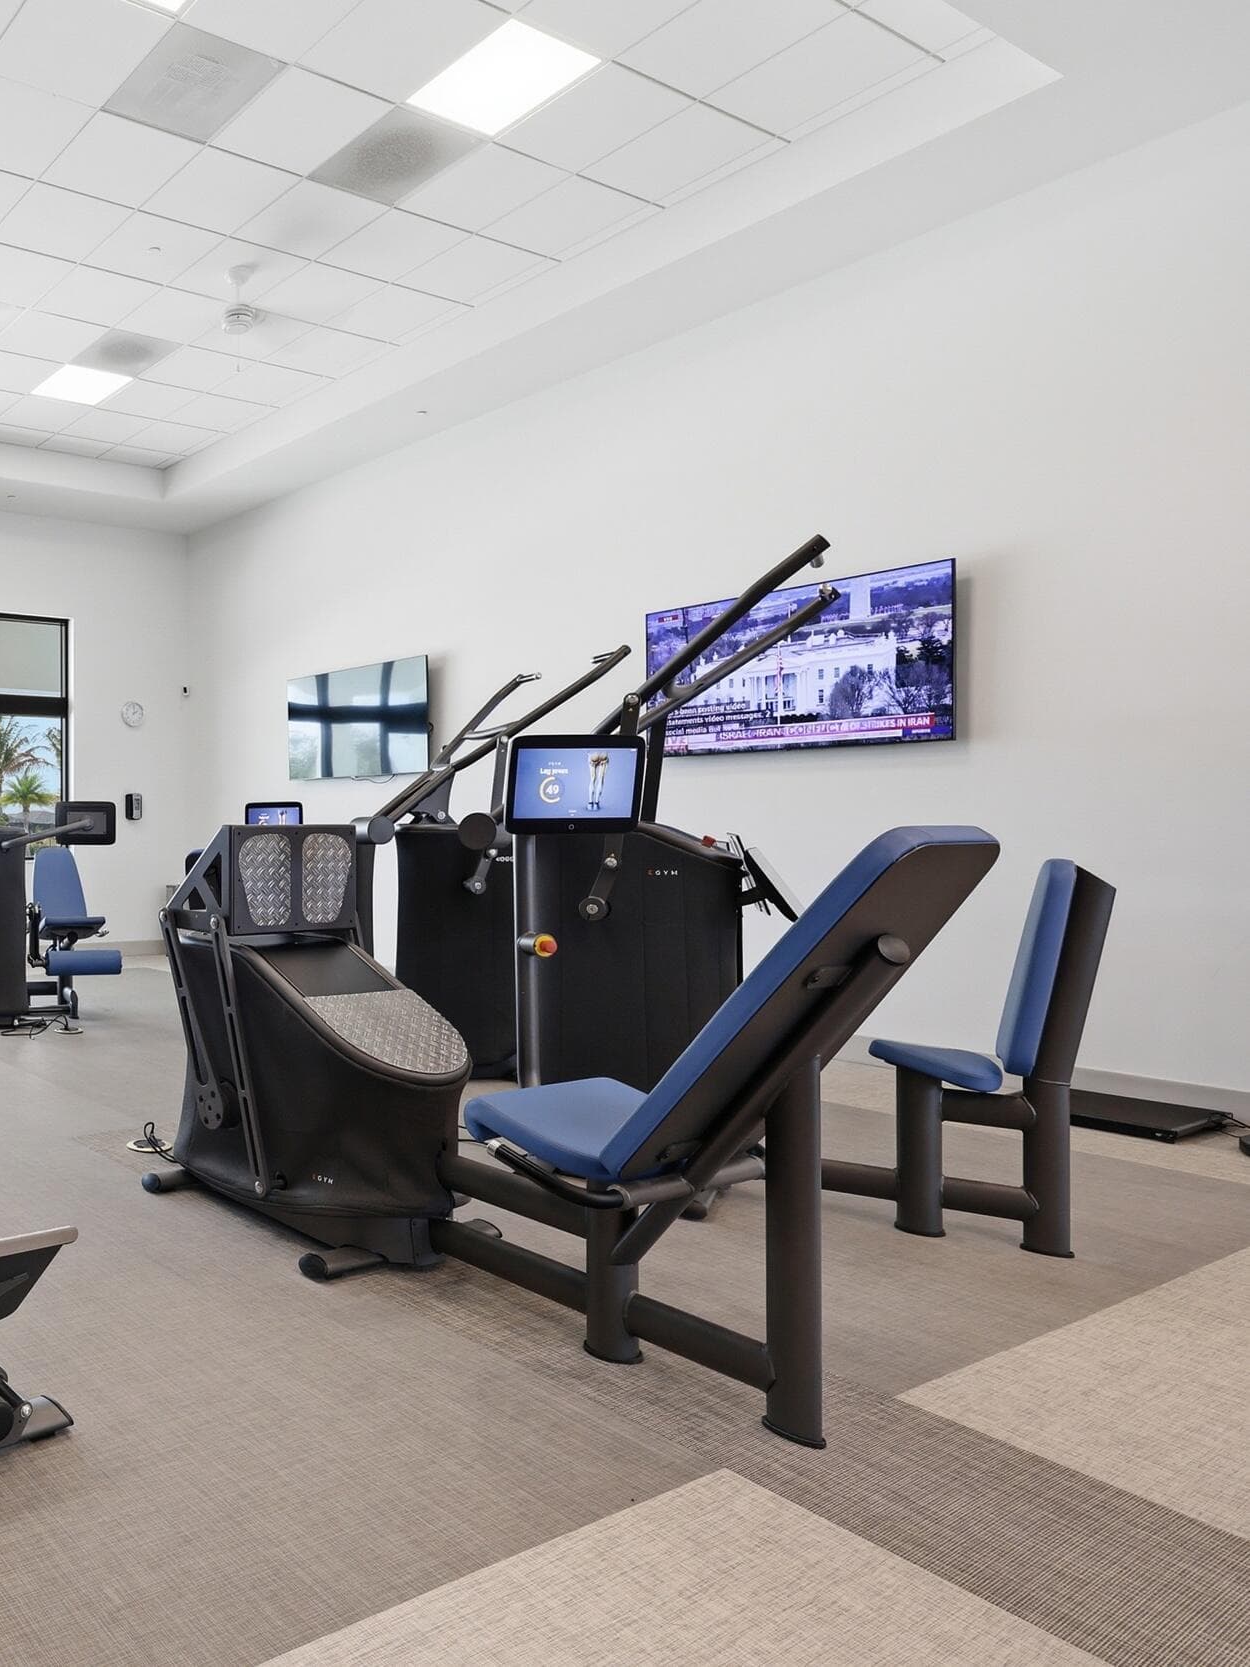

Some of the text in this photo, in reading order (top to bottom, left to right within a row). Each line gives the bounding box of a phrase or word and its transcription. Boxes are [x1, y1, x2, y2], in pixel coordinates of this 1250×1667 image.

[726, 702, 746, 711] video
[704, 714, 724, 722] video
[897, 717, 906, 727] IN
[907, 716, 930, 727] IRAN
[545, 784, 559, 794] 49
